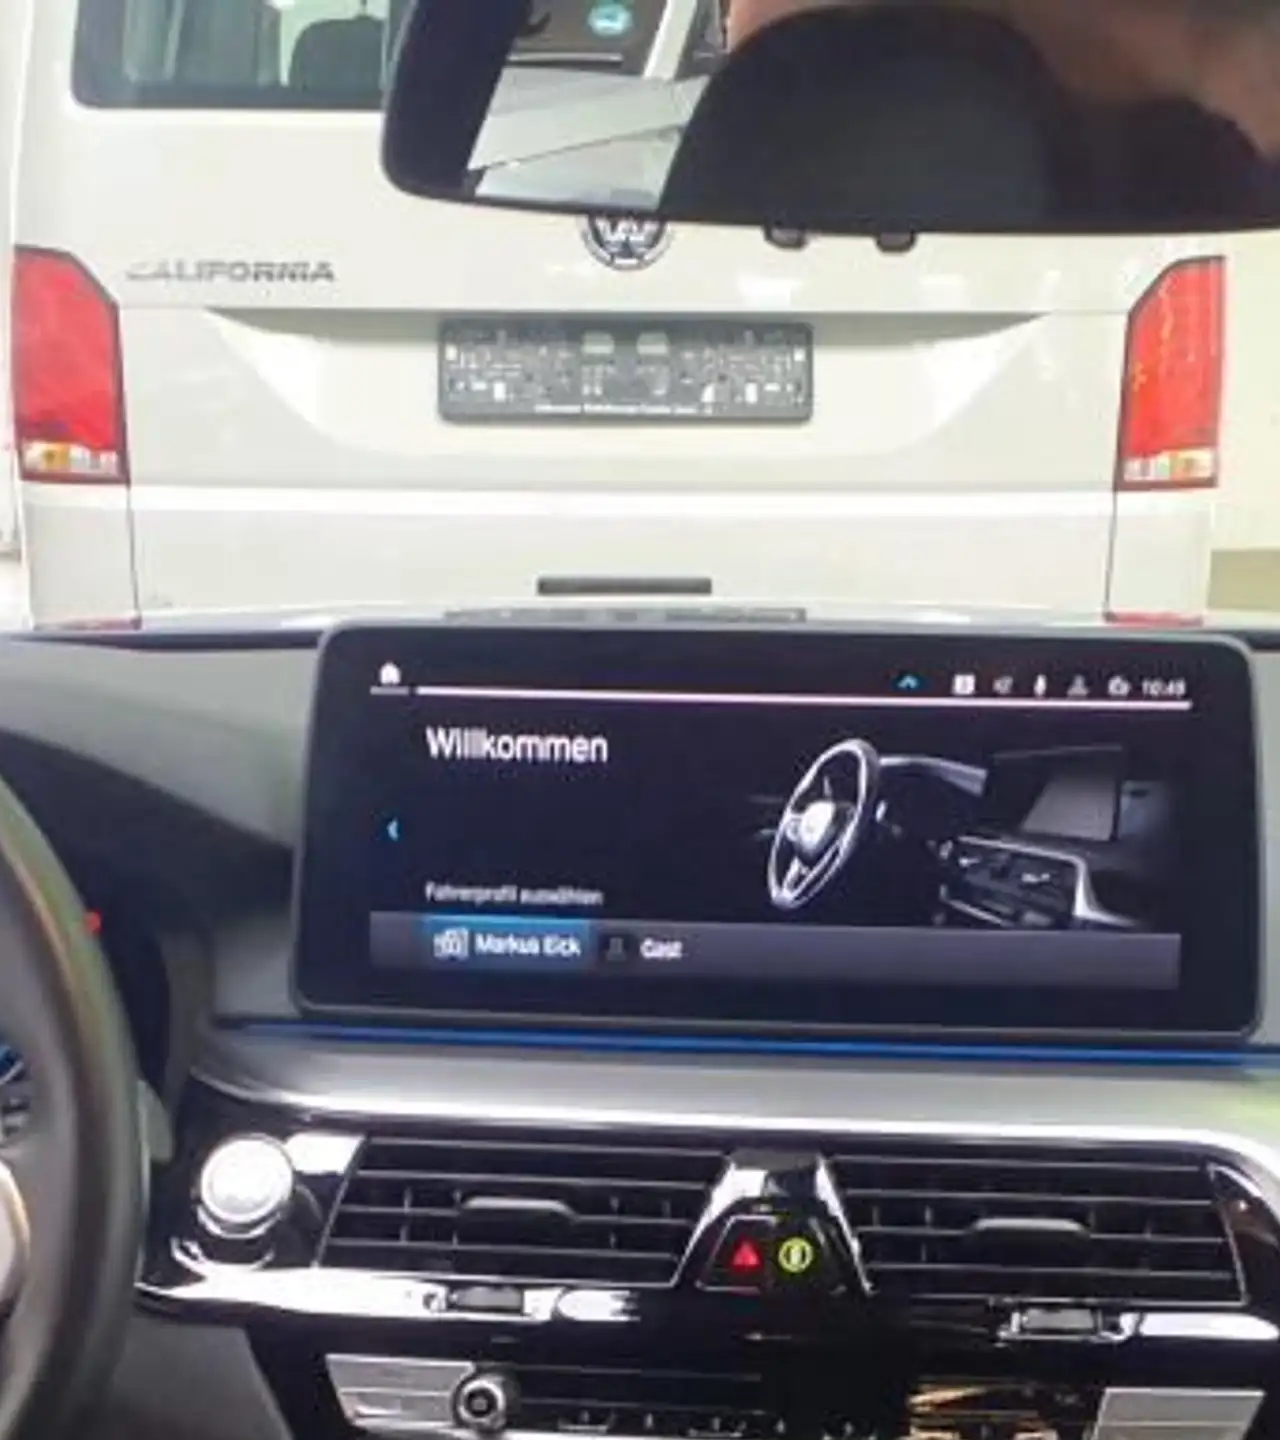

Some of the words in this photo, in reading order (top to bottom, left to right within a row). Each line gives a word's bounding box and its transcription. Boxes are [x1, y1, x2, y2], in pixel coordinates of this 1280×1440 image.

[125, 258, 336, 284] CALIFORNIA
[424, 726, 609, 764] Willkommen
[474, 930, 540, 957] Markus
